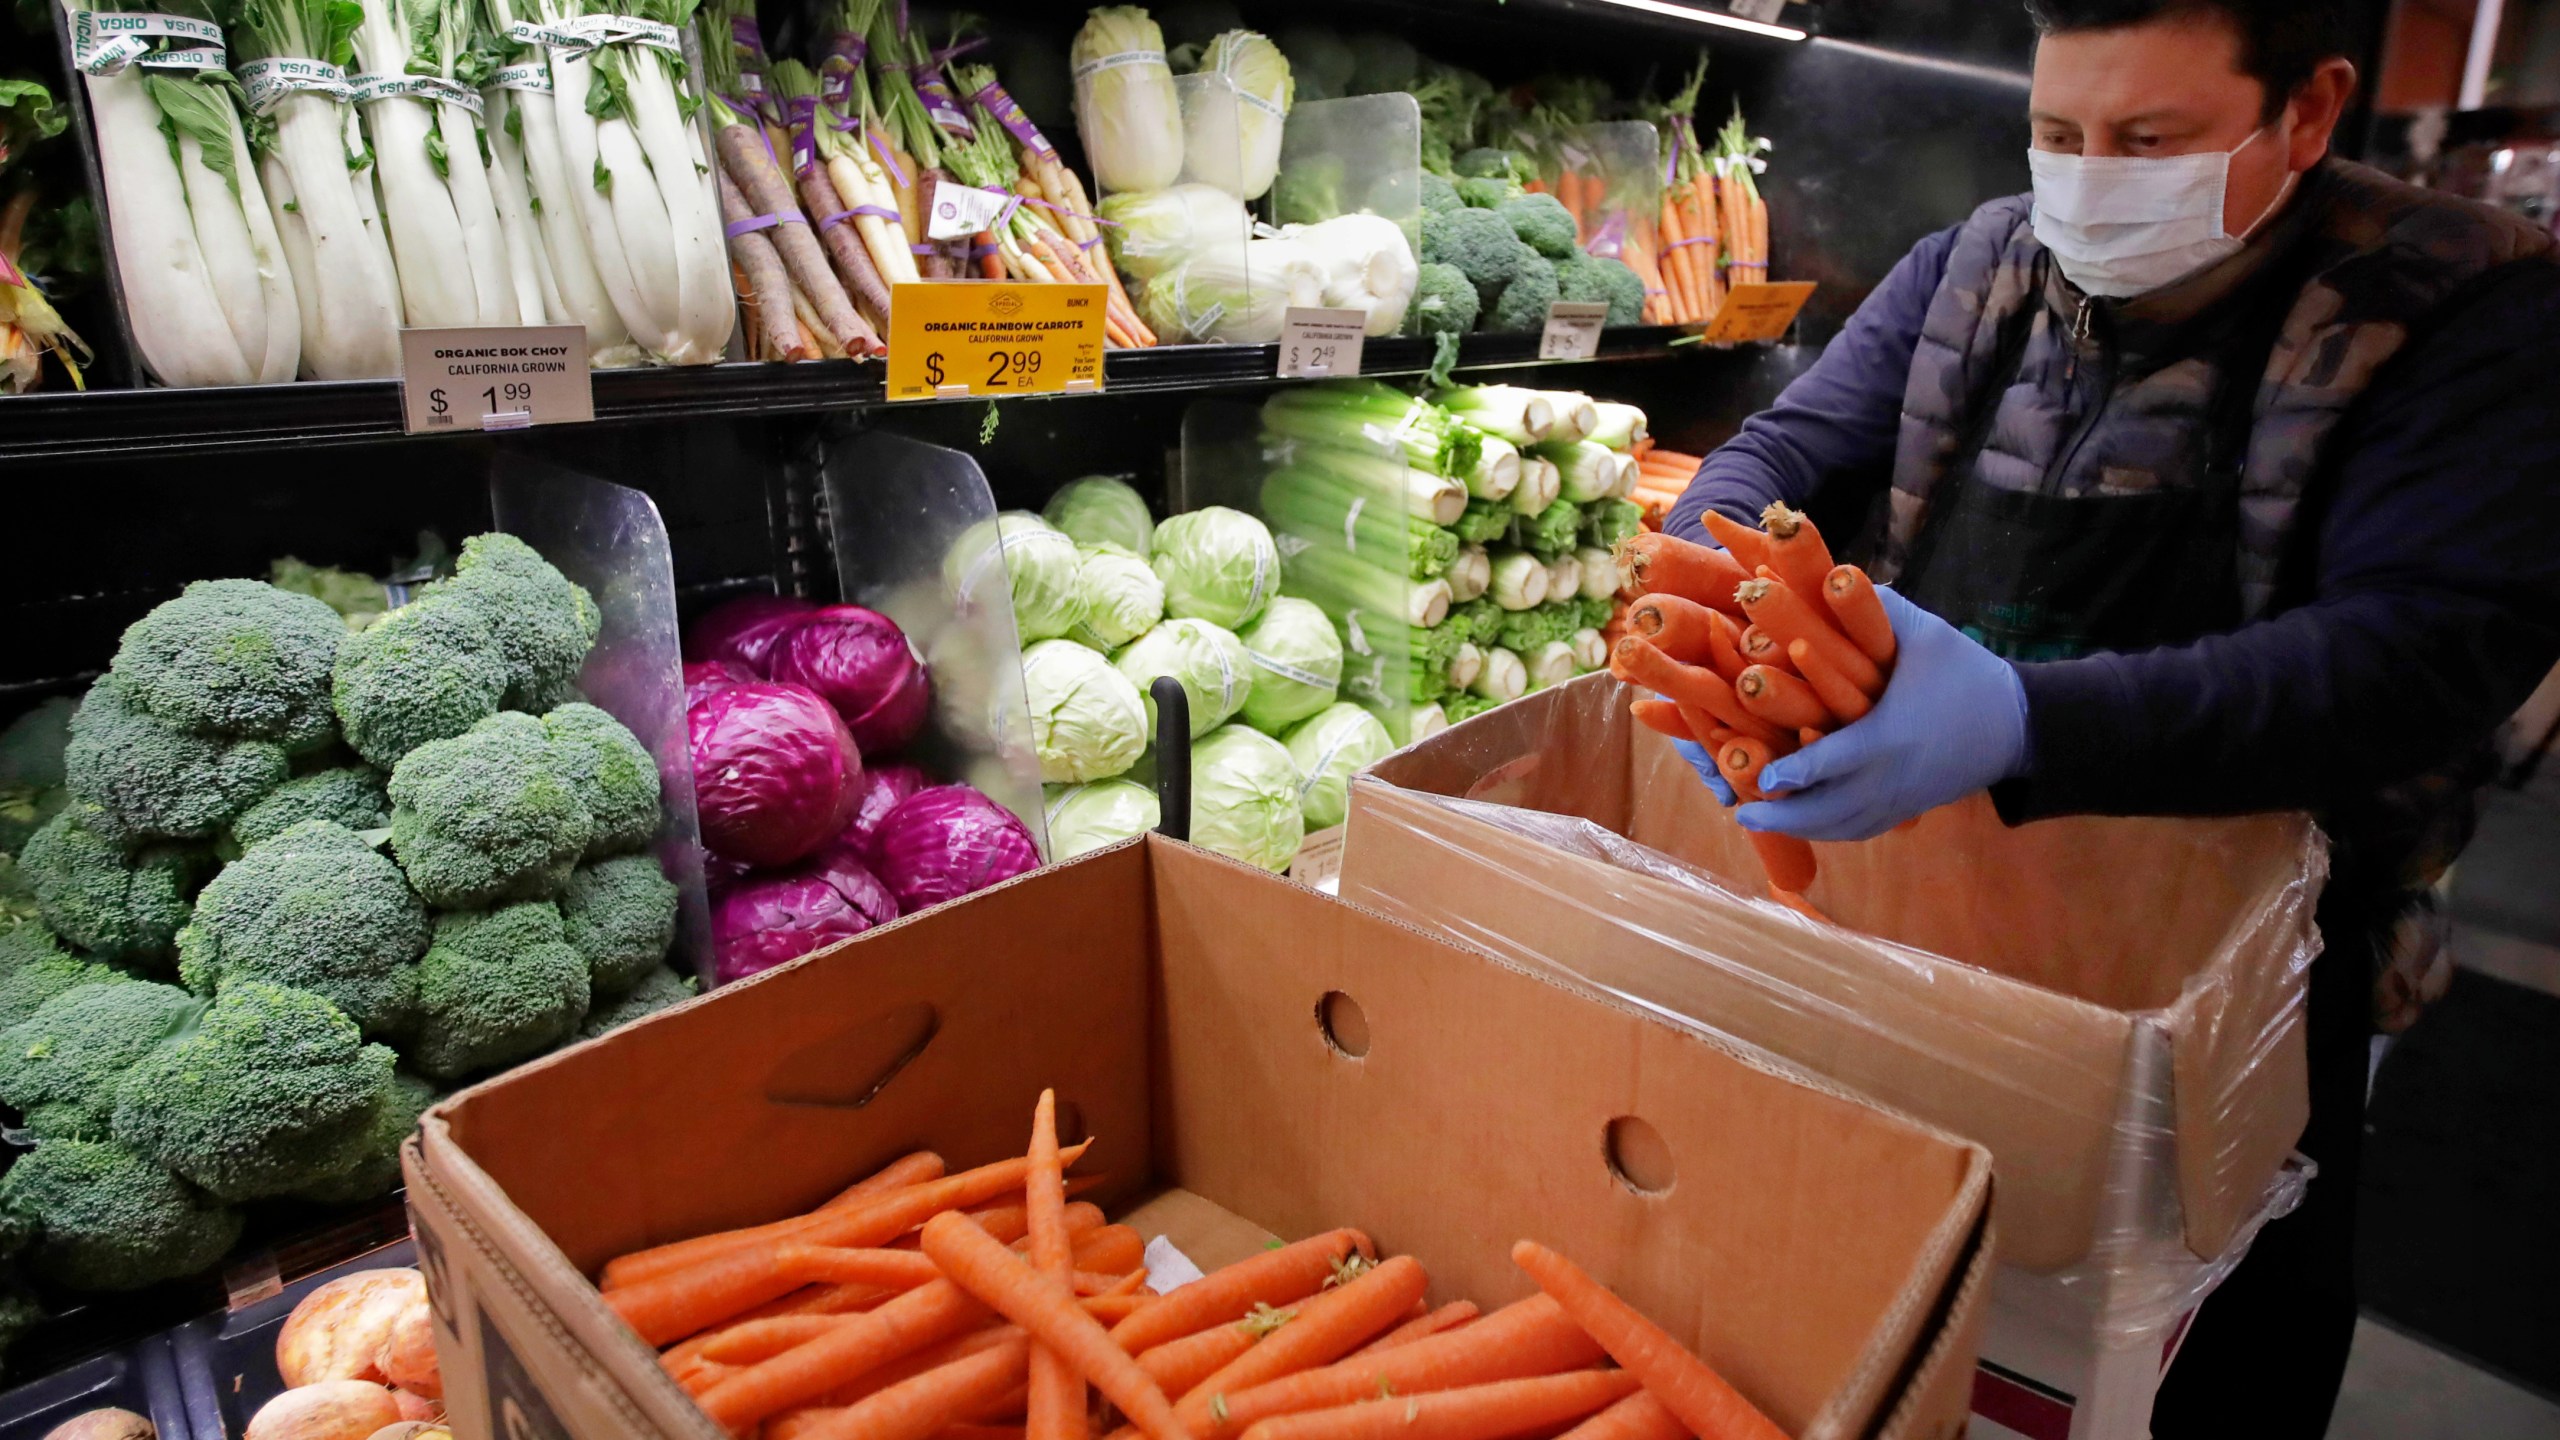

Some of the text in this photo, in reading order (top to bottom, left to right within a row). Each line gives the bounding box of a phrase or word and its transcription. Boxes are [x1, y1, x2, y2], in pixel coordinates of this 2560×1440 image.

[163, 18, 197, 33] USA
[201, 26, 217, 37] OF
[279, 62, 311, 75] USA
[316, 66, 335, 79] OF
[378, 82, 406, 93] USA
[411, 80, 428, 91] OF
[1067, 299, 1089, 307] BUNCH
[924, 320, 1083, 332] ORGANIC RAINBOW CARROTS
[968, 334, 1044, 343] CALIFORNIA GROWN
[434, 347, 568, 359] ORGANIC BOK CHOY
[1290, 346, 1335, 366] $ 2 49
[448, 362, 566, 376] CALIFORNIA GROWN
[925, 350, 1042, 389] $ 2 99
[1072, 365, 1094, 373] $1.00
[1017, 377, 1035, 387] EA
[430, 383, 532, 415] $ 1 99
